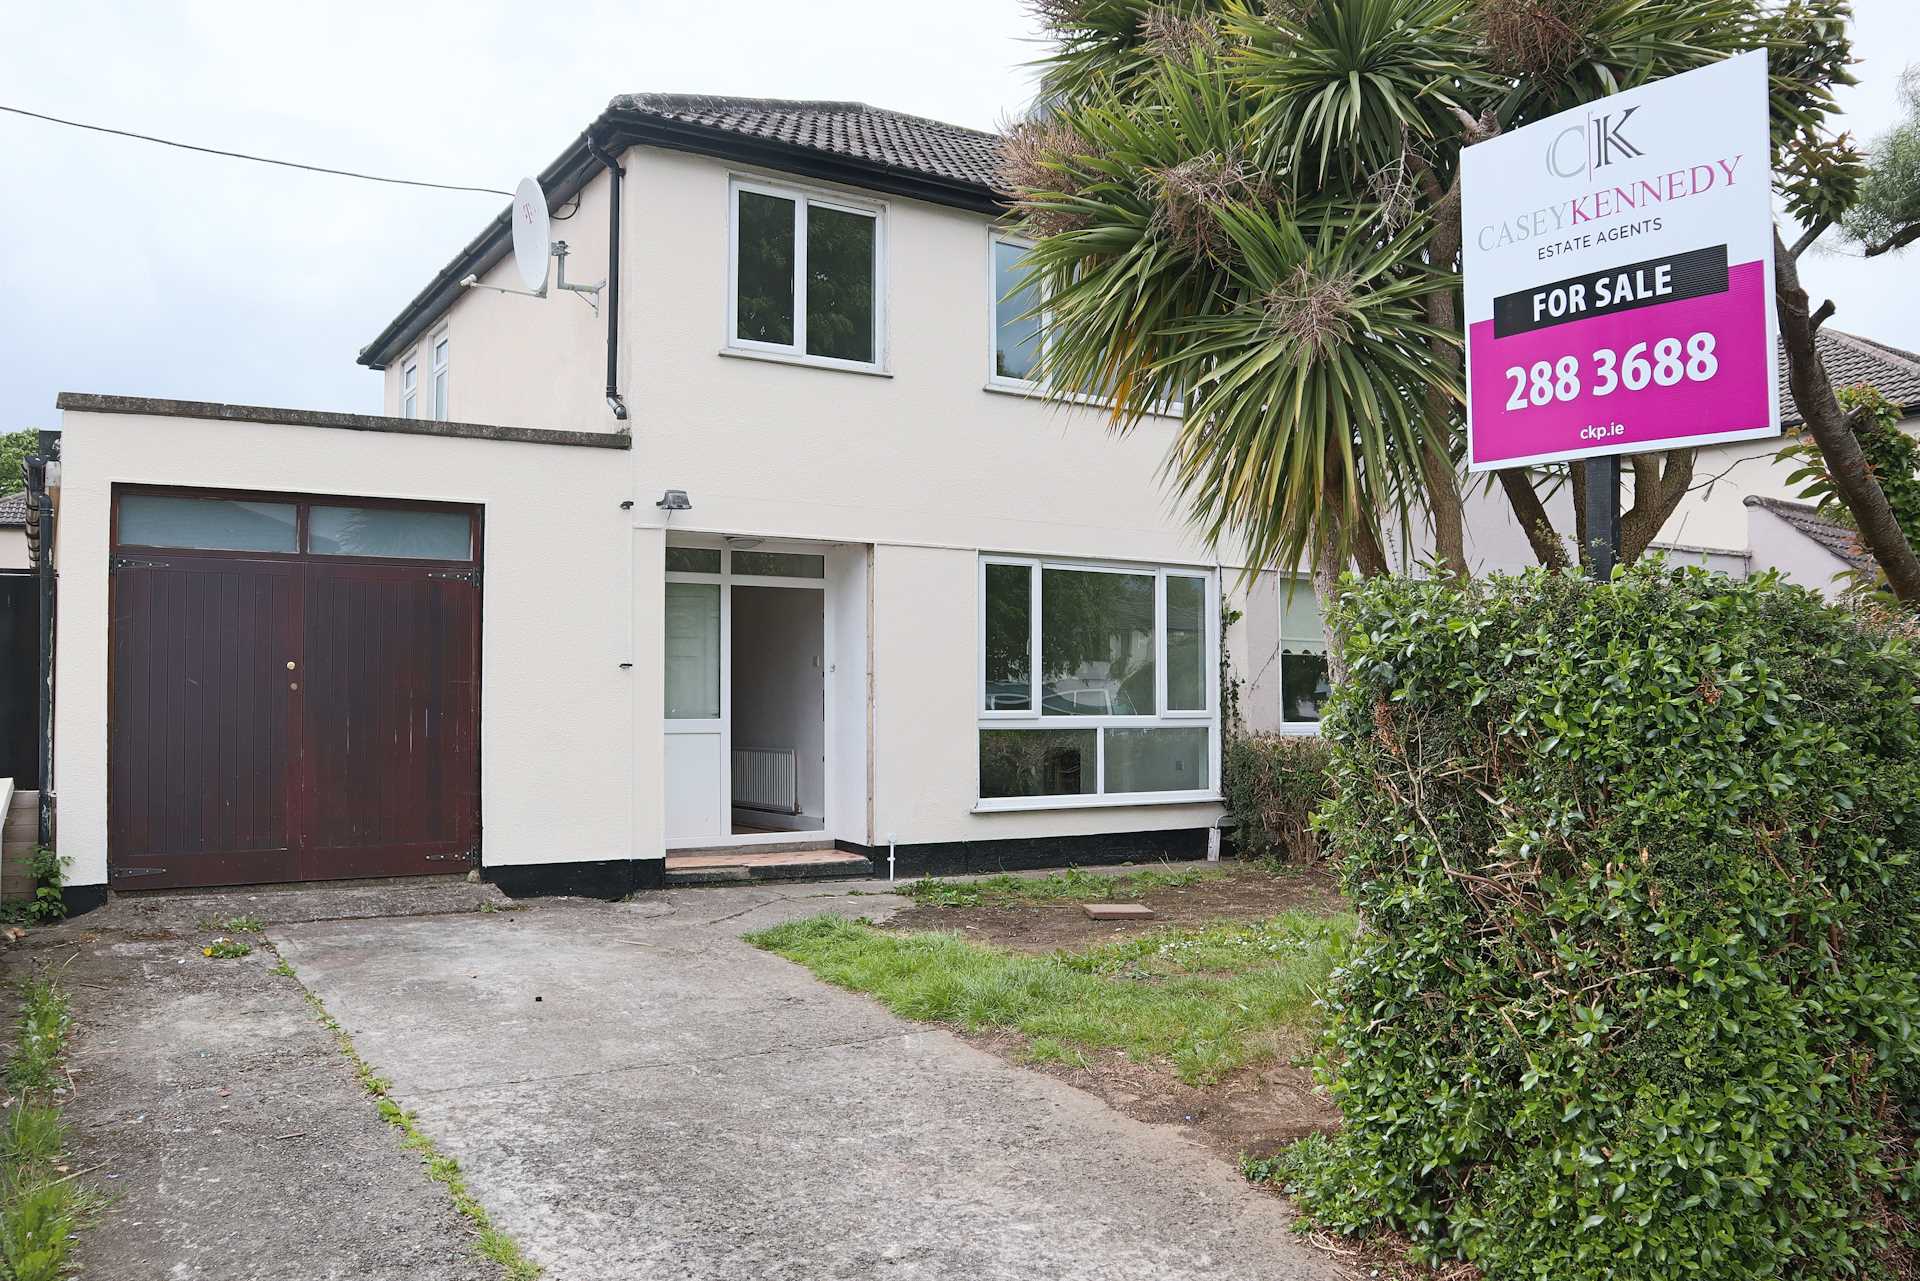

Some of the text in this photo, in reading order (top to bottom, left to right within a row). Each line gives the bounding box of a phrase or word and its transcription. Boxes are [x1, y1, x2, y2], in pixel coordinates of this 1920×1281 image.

[1538, 217, 1663, 261] ESTATE AGENTS
[1533, 264, 1673, 322] FOR SALE
[1505, 332, 1719, 411] 288 3688
[1580, 421, 1625, 440] ckp.ie
